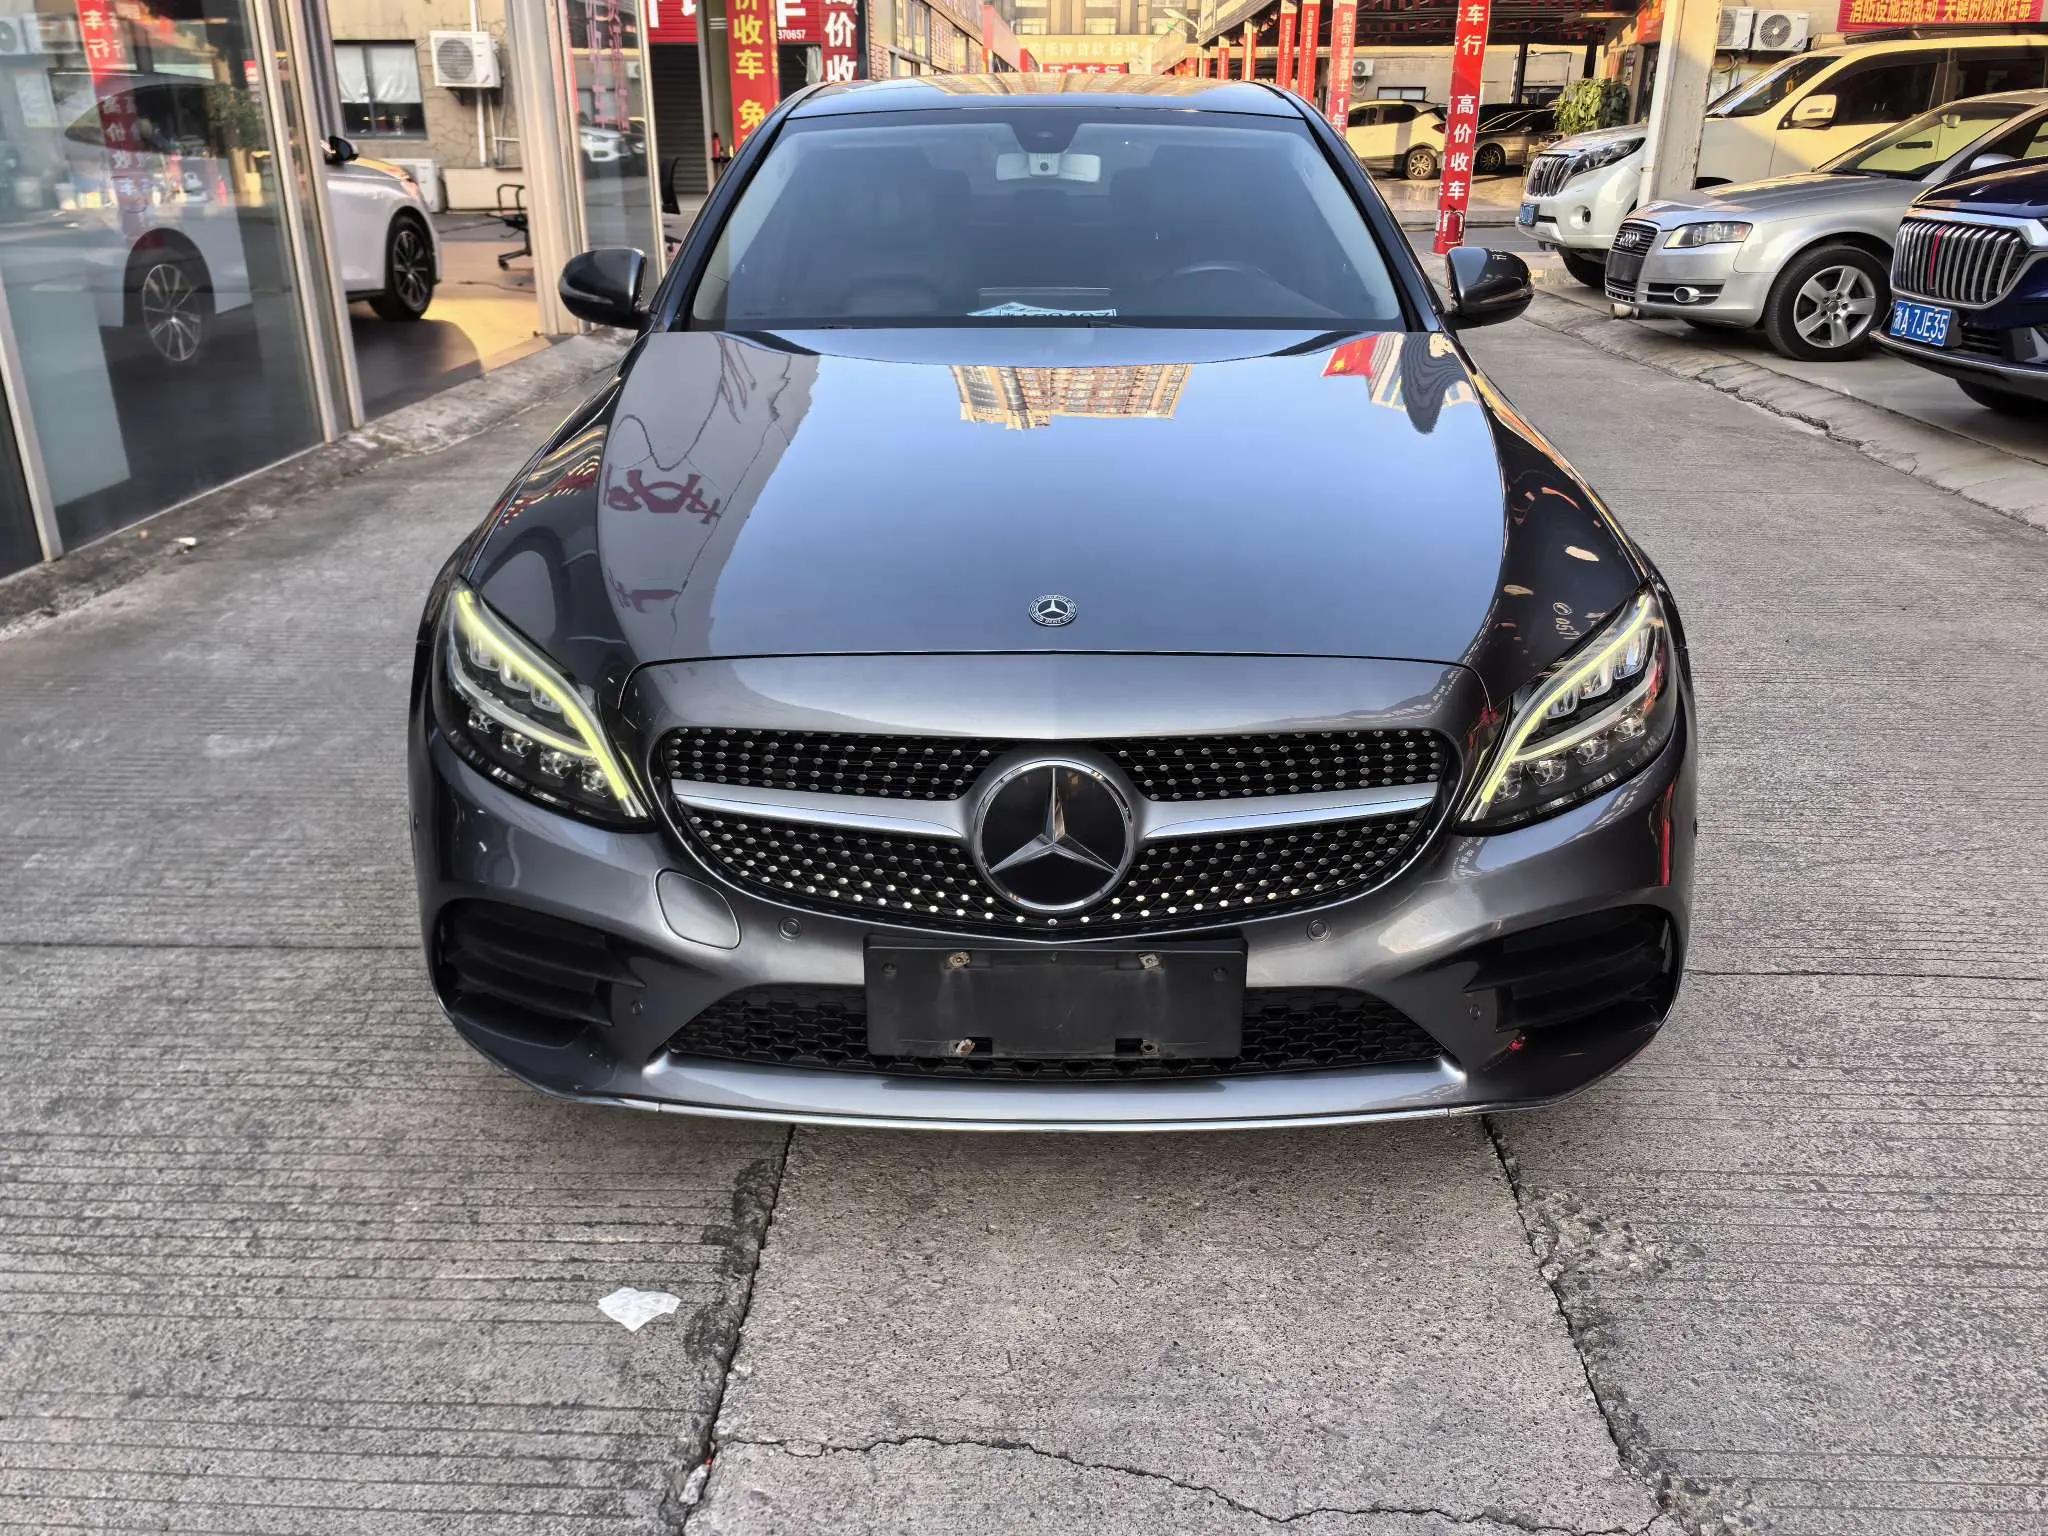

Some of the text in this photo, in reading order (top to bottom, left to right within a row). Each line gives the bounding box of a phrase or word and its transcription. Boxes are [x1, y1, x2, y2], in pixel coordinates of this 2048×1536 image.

[824, 0, 857, 82] 价收
[1462, 3, 1485, 56] 车行
[1447, 93, 1476, 201] 高价收车
